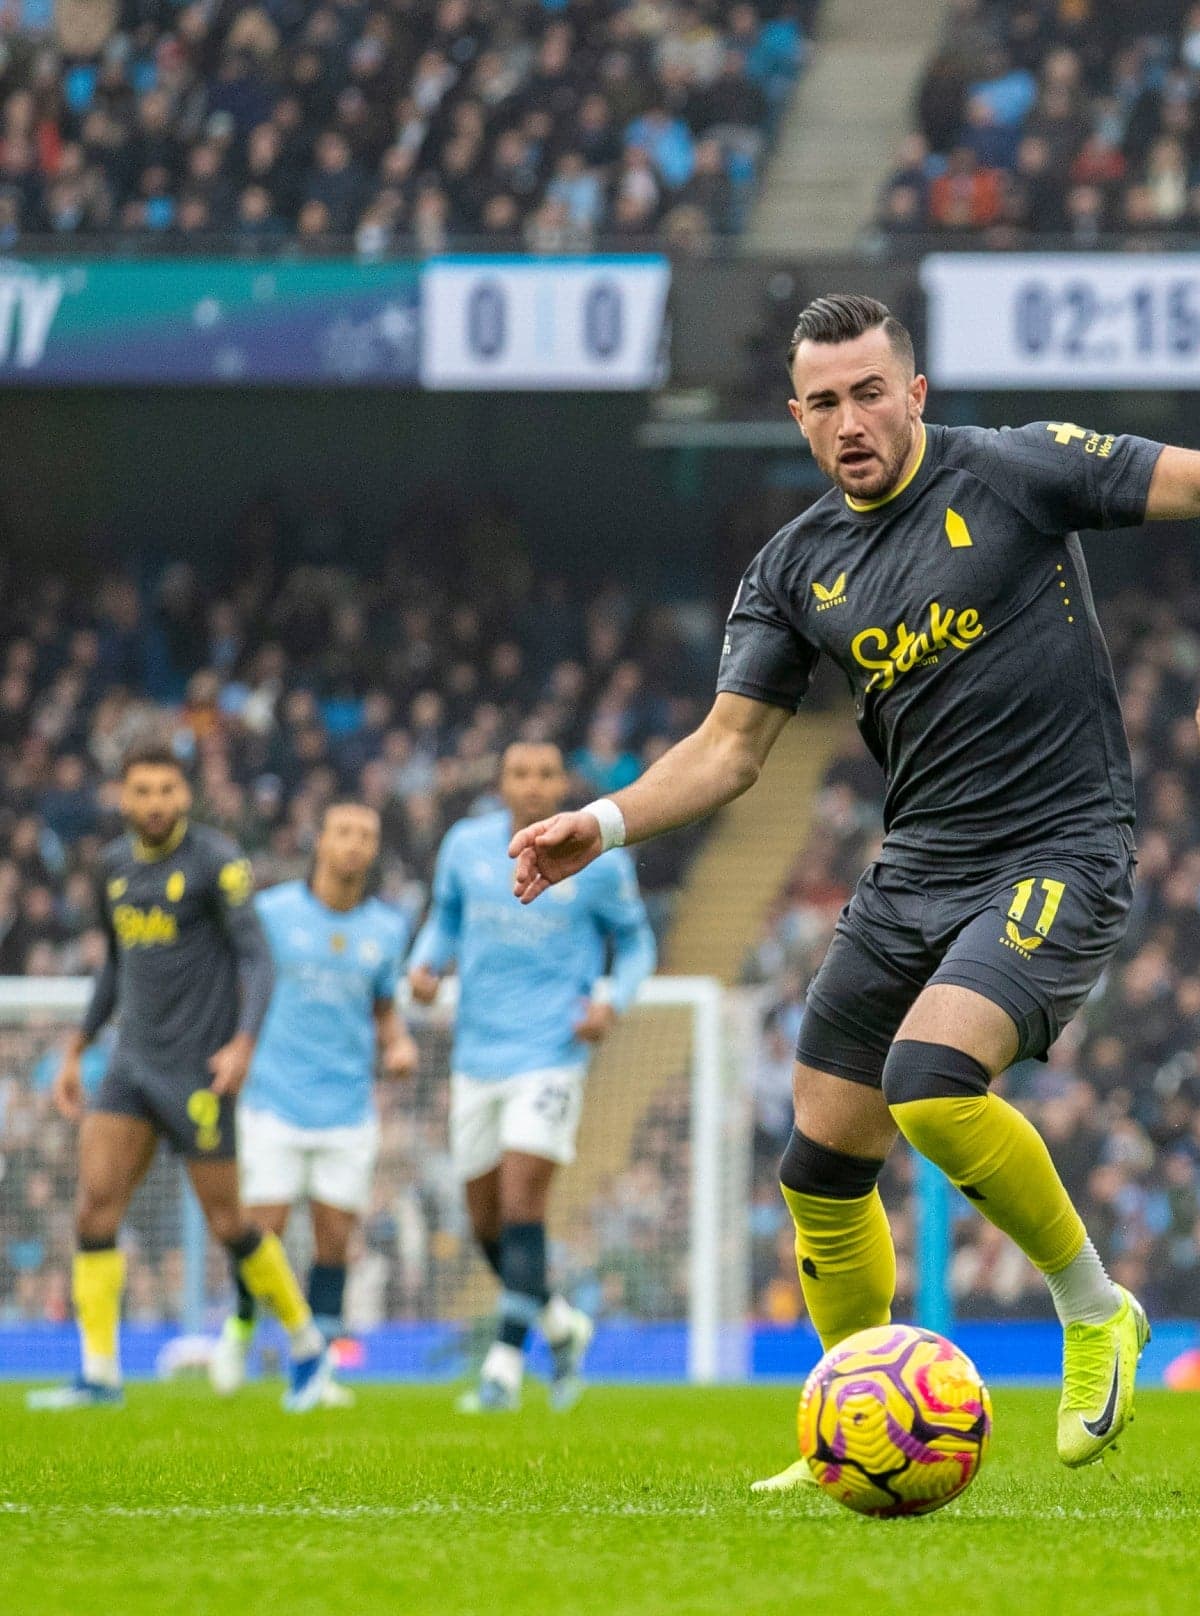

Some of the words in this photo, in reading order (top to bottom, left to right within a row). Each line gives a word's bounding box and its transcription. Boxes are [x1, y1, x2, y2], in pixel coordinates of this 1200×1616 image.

[468, 281, 509, 360] 0
[585, 281, 626, 361] 0
[851, 602, 983, 693] Stake
[1007, 878, 1066, 937] 11
